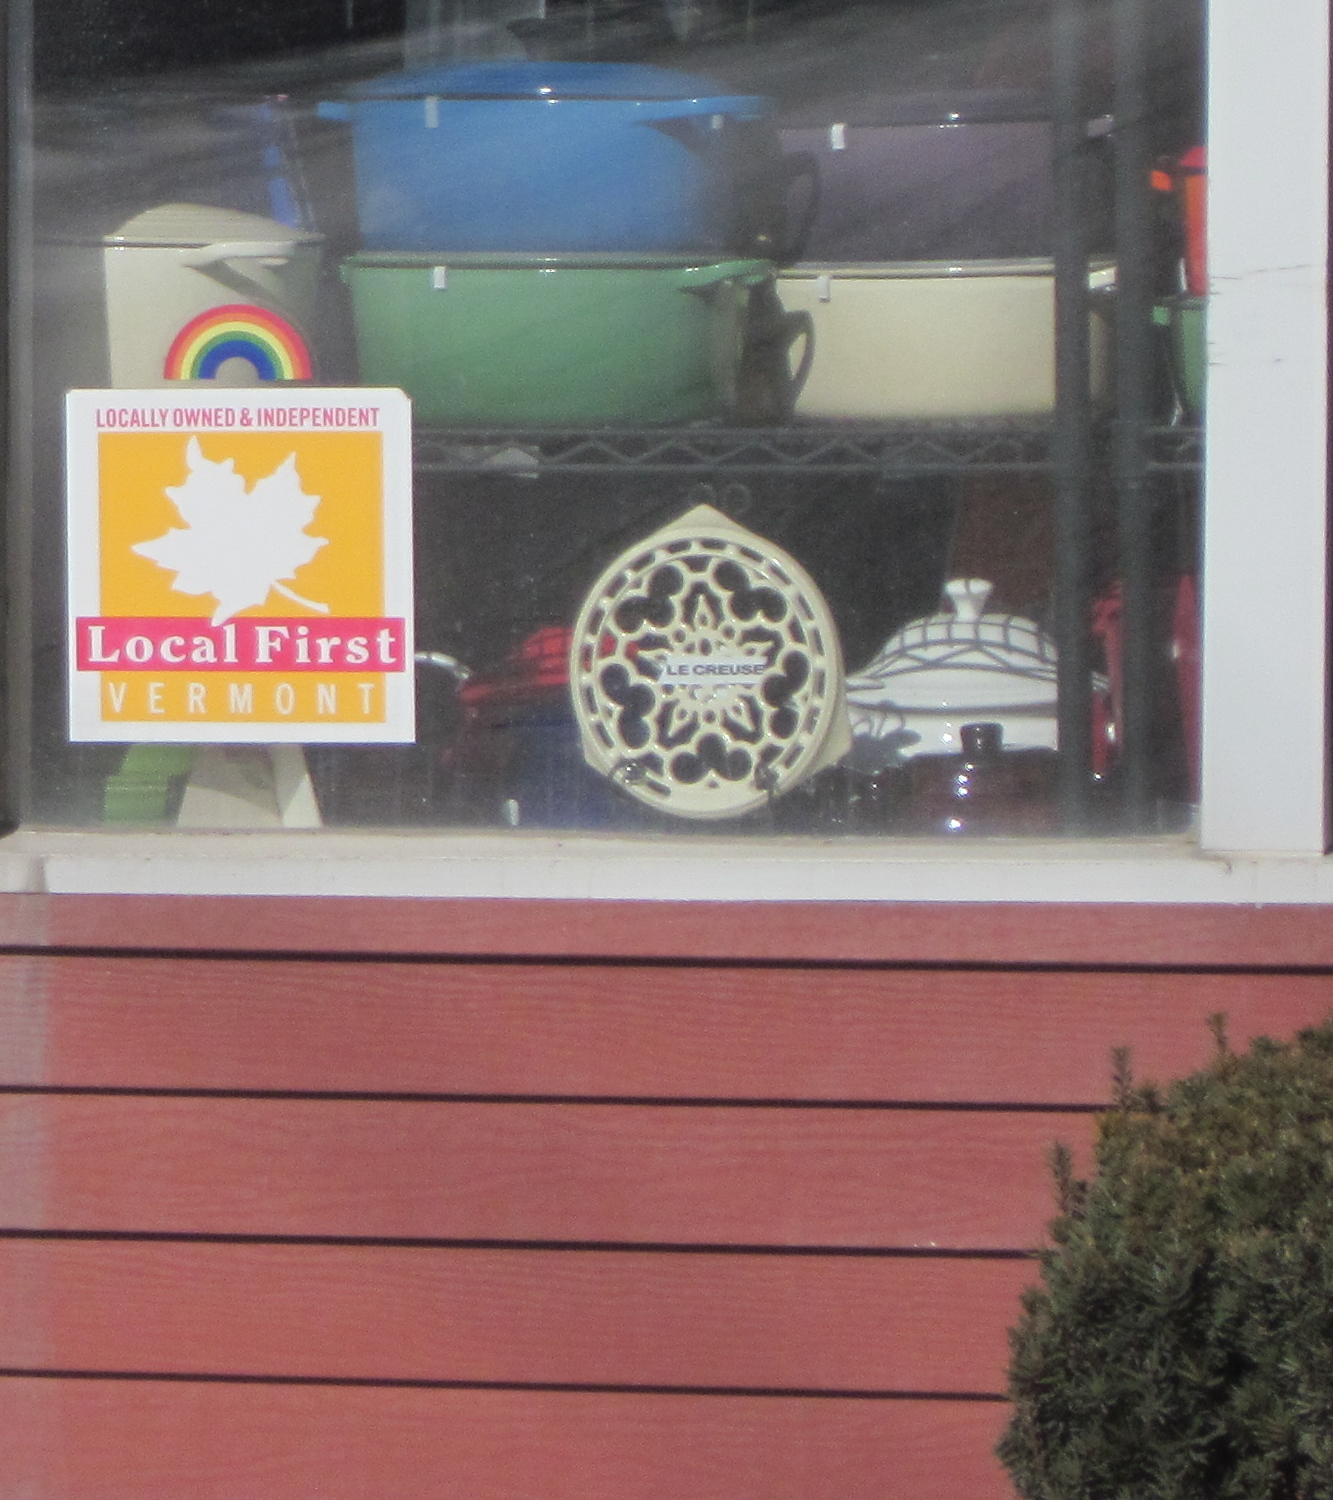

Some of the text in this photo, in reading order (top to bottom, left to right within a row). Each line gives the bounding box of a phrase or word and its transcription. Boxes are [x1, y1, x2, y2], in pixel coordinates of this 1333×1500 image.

[96, 407, 380, 428] LOCALLY OWNED & INDEPENDENT
[87, 623, 398, 665] Local First
[666, 664, 690, 676] LE
[107, 682, 377, 716] VERMONT
